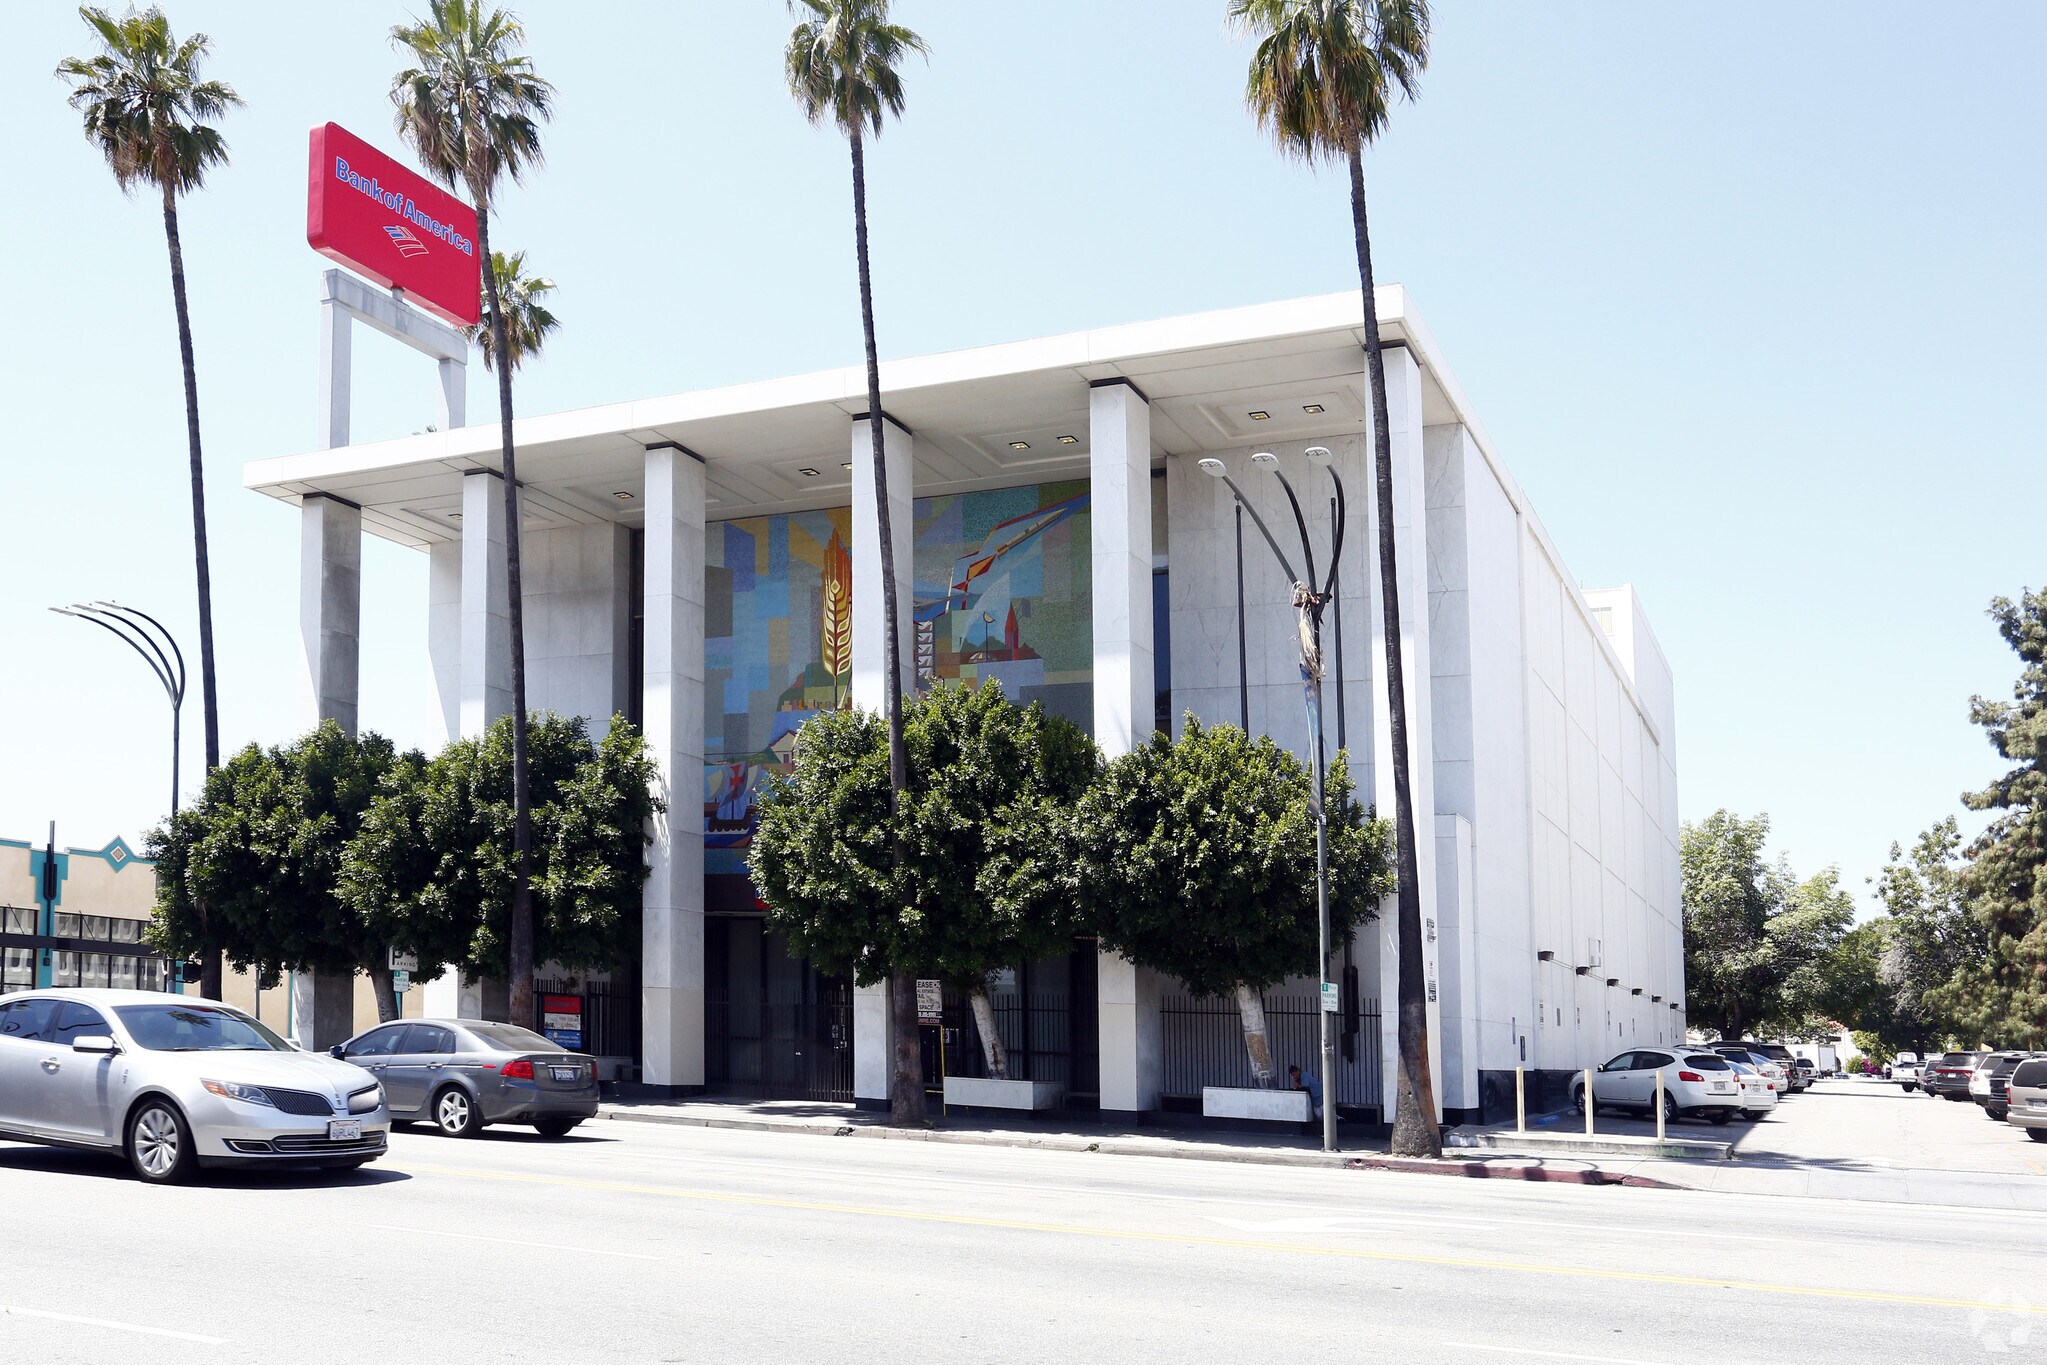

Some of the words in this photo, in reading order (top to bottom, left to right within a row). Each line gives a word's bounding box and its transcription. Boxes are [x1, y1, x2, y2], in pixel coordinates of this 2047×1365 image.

[336, 156, 384, 205] Bank
[384, 193, 403, 214] of
[403, 199, 473, 256] America
